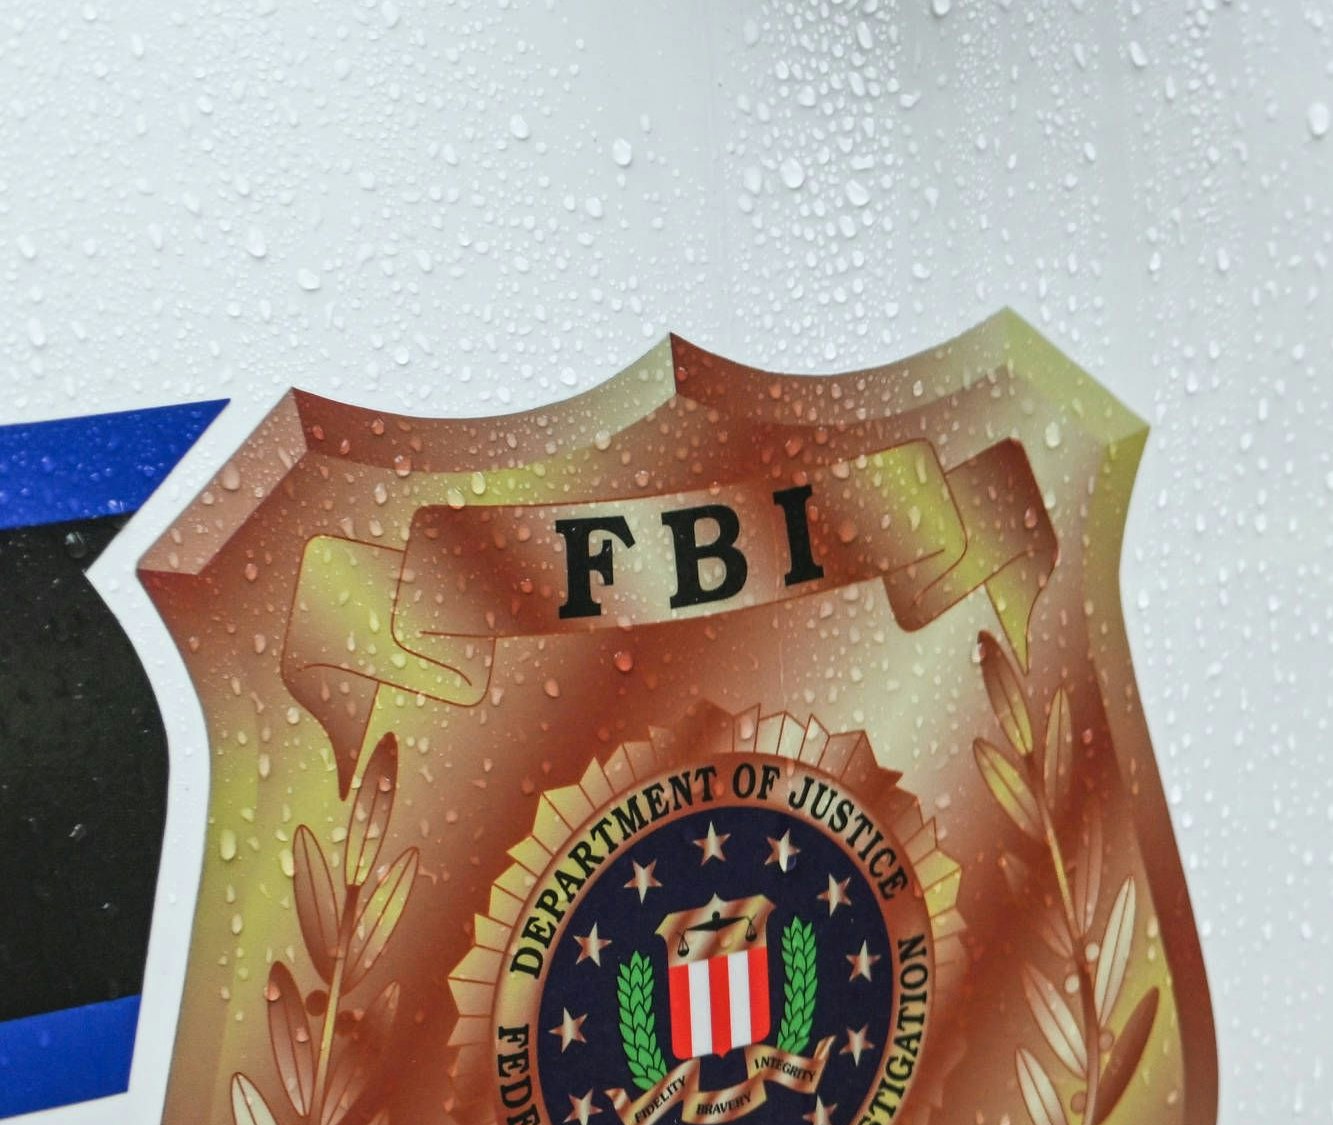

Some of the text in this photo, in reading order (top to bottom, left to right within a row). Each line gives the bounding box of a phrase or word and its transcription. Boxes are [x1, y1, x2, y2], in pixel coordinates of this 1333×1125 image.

[555, 484, 825, 620] FBI
[510, 763, 907, 979] DEPARTMENT OF JUSTICE
[634, 1056, 816, 1123] FIDELITY BRAVERY INTEGRITY
